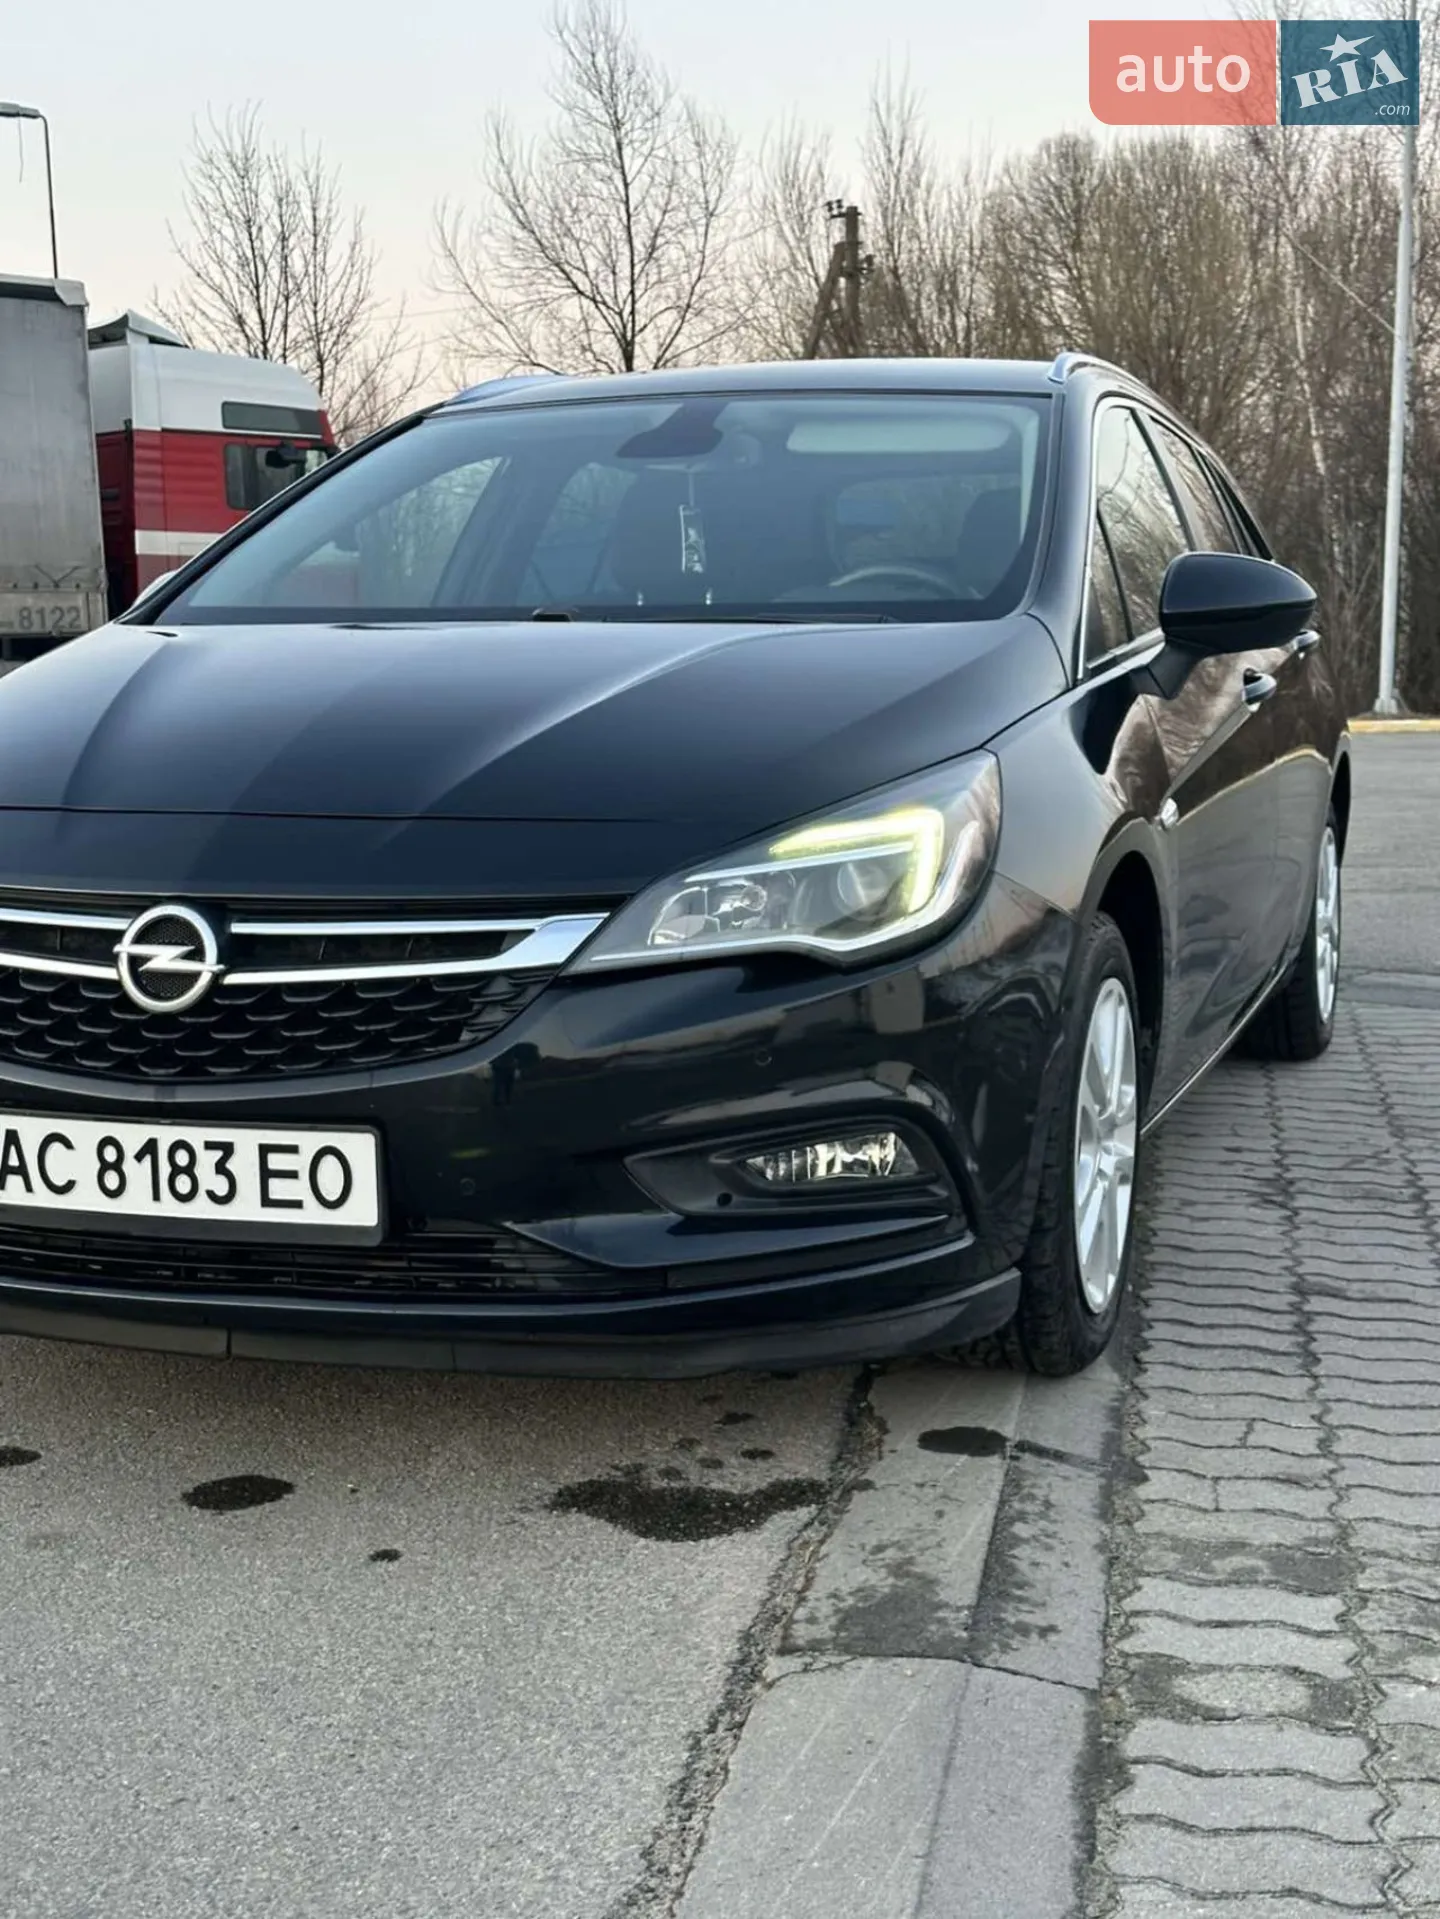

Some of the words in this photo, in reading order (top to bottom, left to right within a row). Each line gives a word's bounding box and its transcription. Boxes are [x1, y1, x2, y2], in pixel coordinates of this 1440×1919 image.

[19, 606, 82, 630] 8122
[0, 1129, 76, 1195] AC
[97, 1136, 237, 1206] 8183
[258, 1143, 353, 1210] EO
